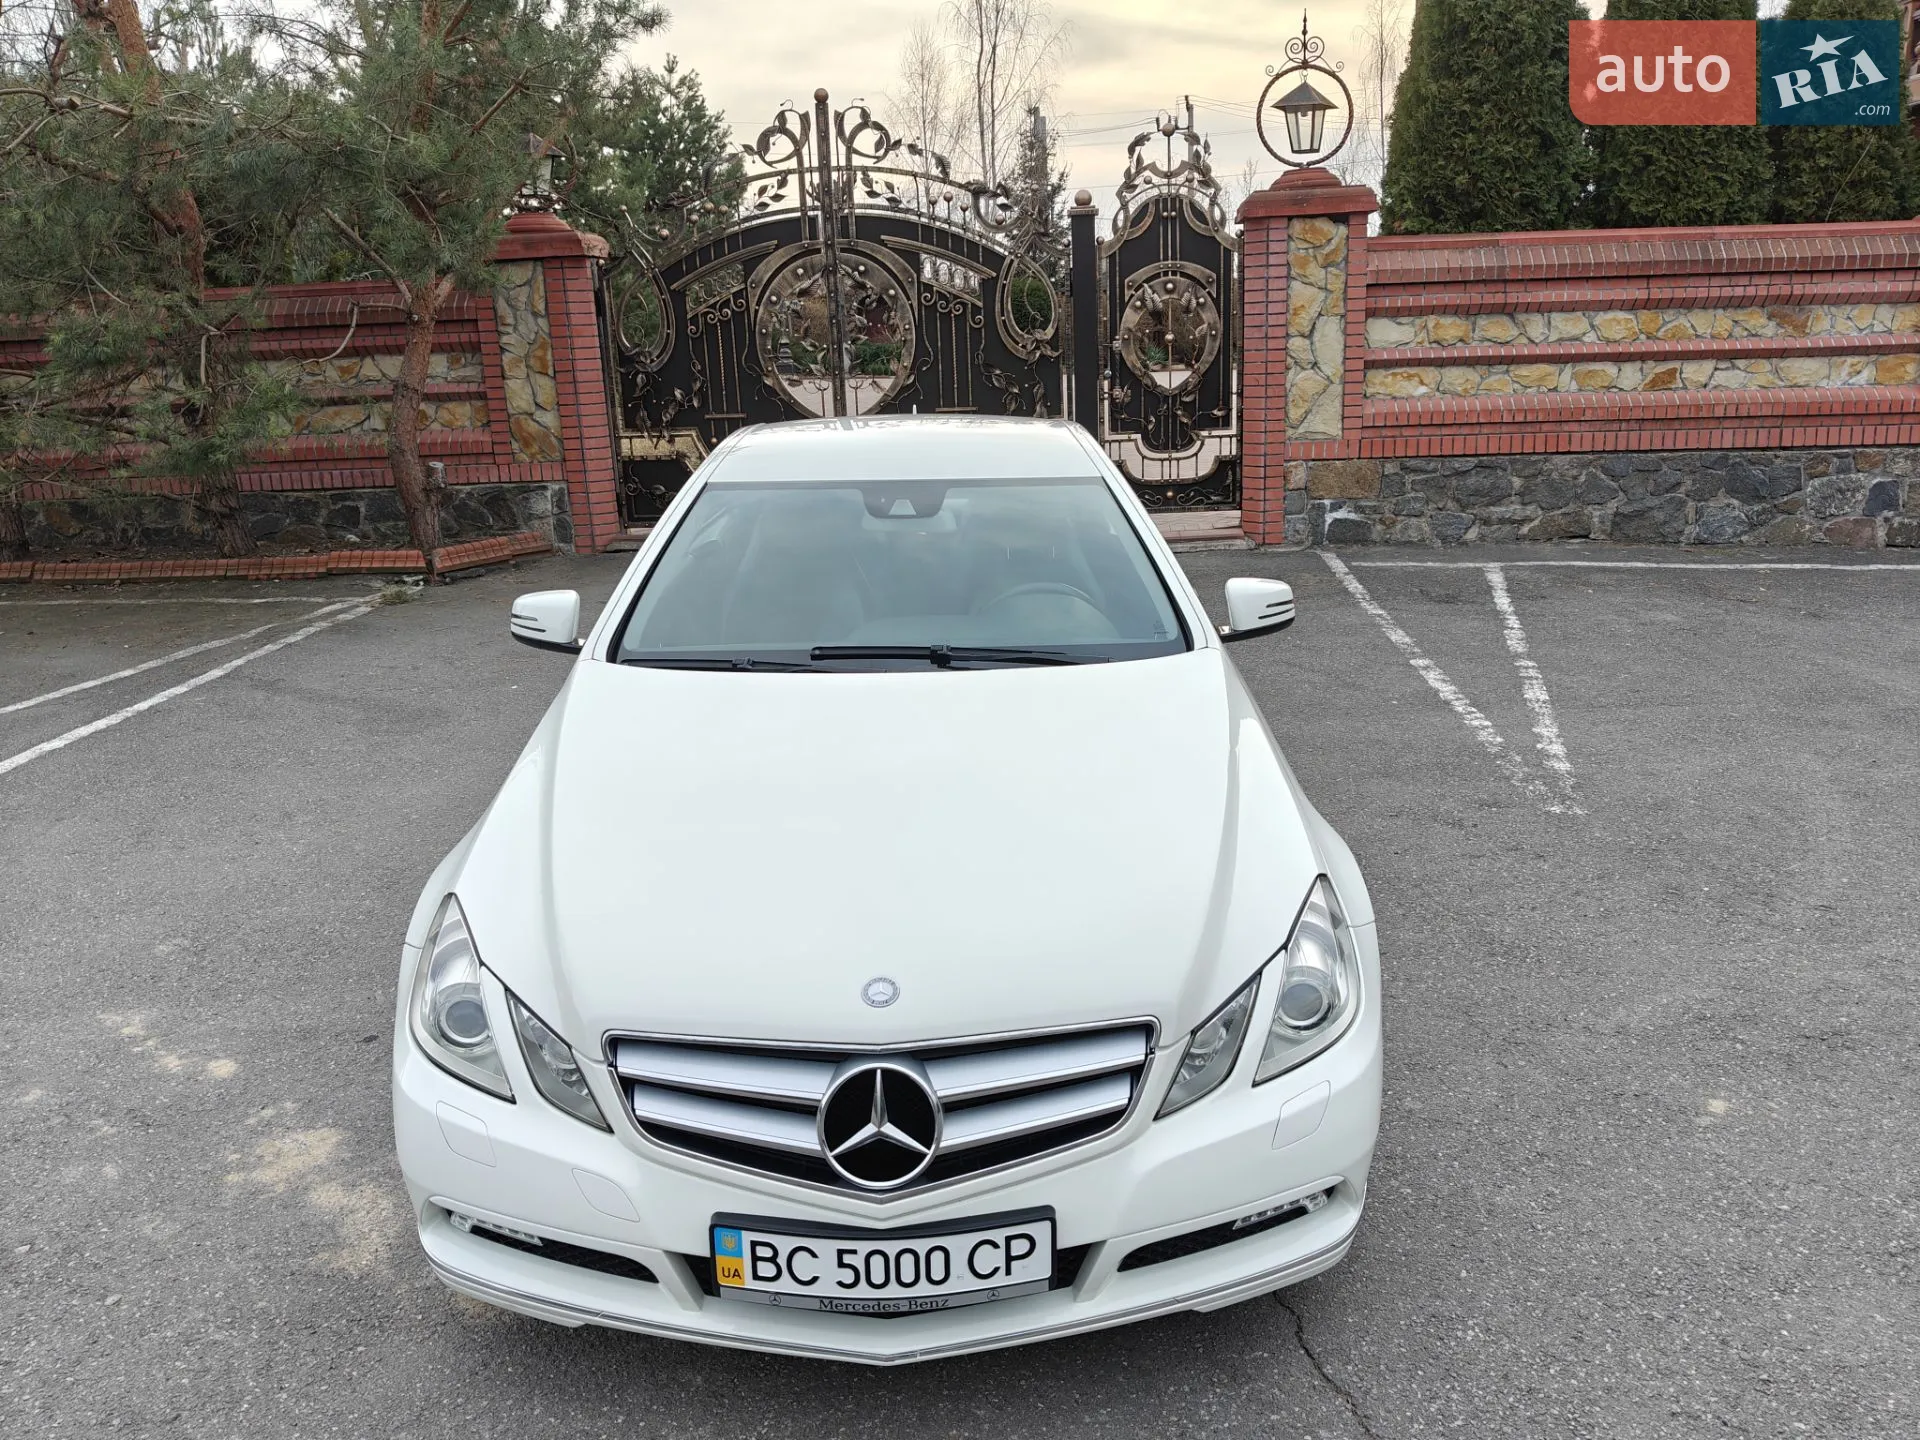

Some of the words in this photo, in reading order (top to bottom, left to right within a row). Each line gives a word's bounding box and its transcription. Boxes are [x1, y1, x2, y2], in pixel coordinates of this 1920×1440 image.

[749, 1240, 820, 1286] BC
[835, 1246, 951, 1289] 5000
[967, 1233, 1037, 1280] CP
[721, 1266, 742, 1280] UA
[818, 1299, 950, 1312] Mercedes-Benz
